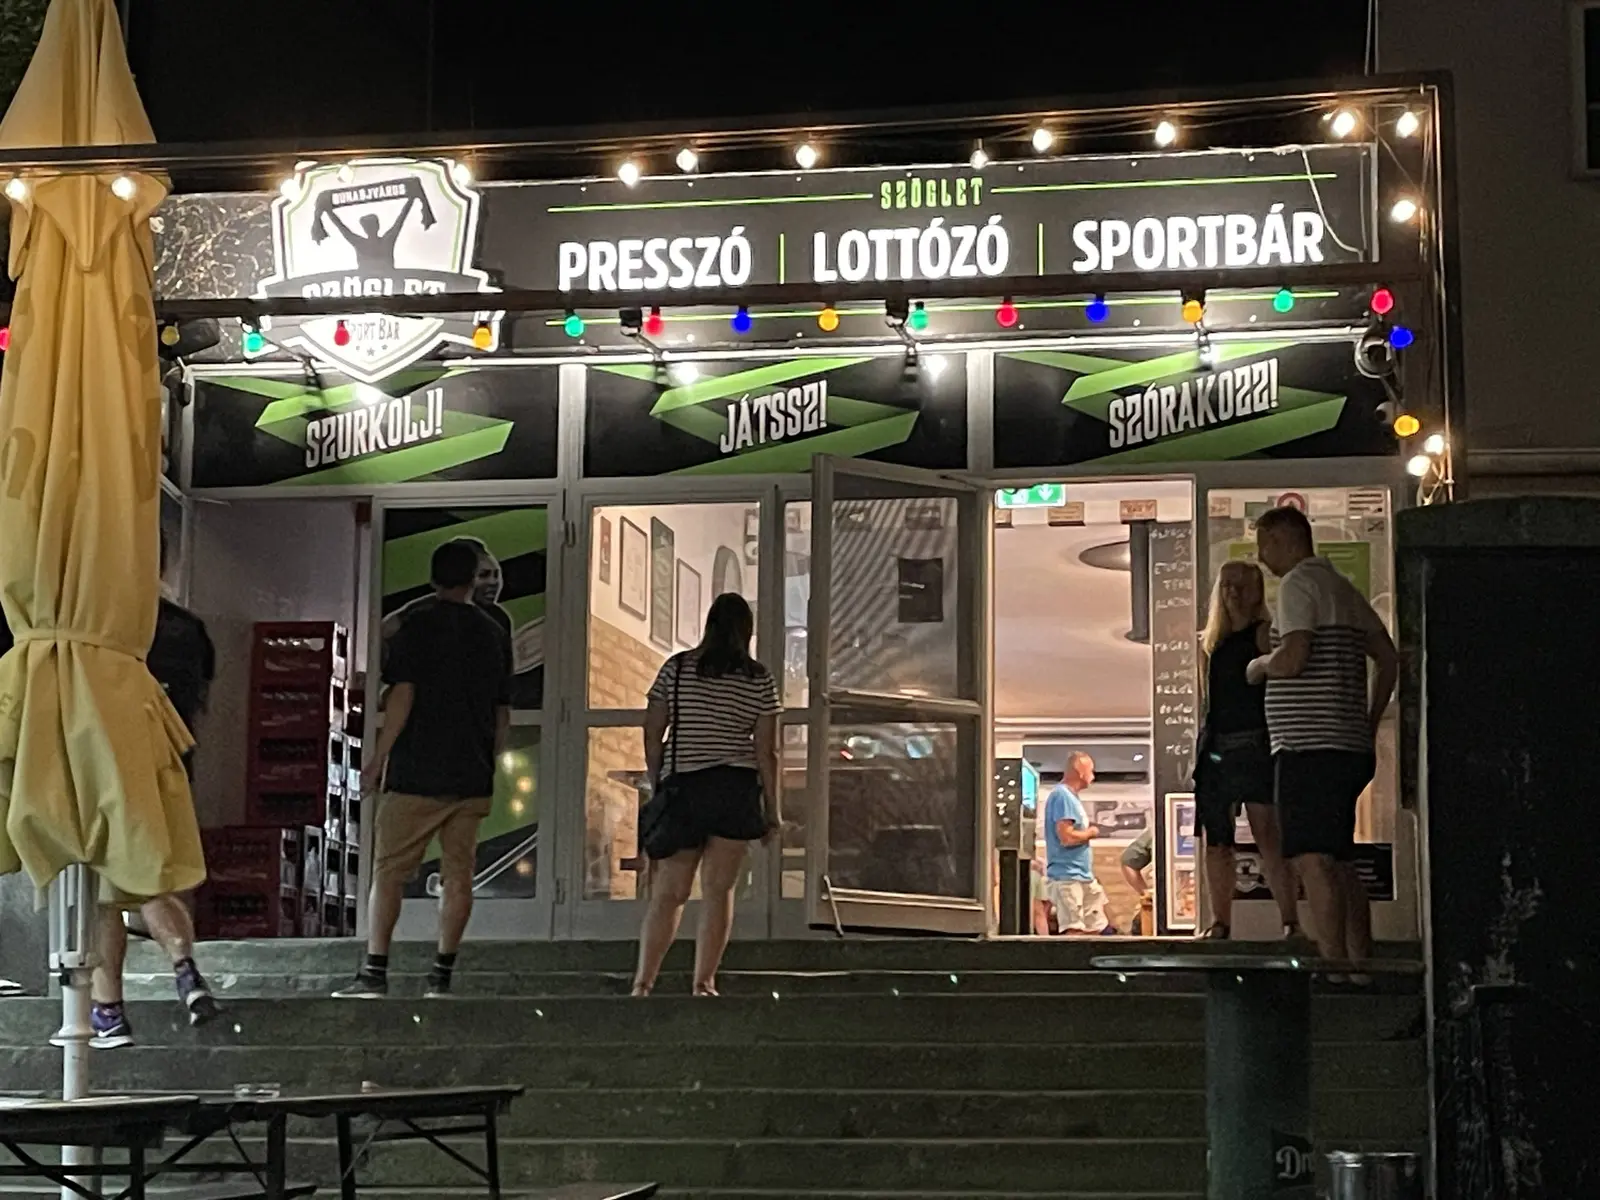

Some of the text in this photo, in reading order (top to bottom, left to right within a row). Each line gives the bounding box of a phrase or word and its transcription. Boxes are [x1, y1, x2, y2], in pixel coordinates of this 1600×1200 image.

[881, 177, 983, 209] SZÖGLET
[559, 225, 752, 291] PRESSZÓ
[813, 215, 1010, 283] LOTTÓZÓ
[1072, 203, 1324, 272] SPORTBÁR
[305, 387, 443, 468] SZURKOLJ!
[720, 380, 827, 453] JÁTSSZ!
[1109, 357, 1279, 448] SZÓRAKOZZ!
